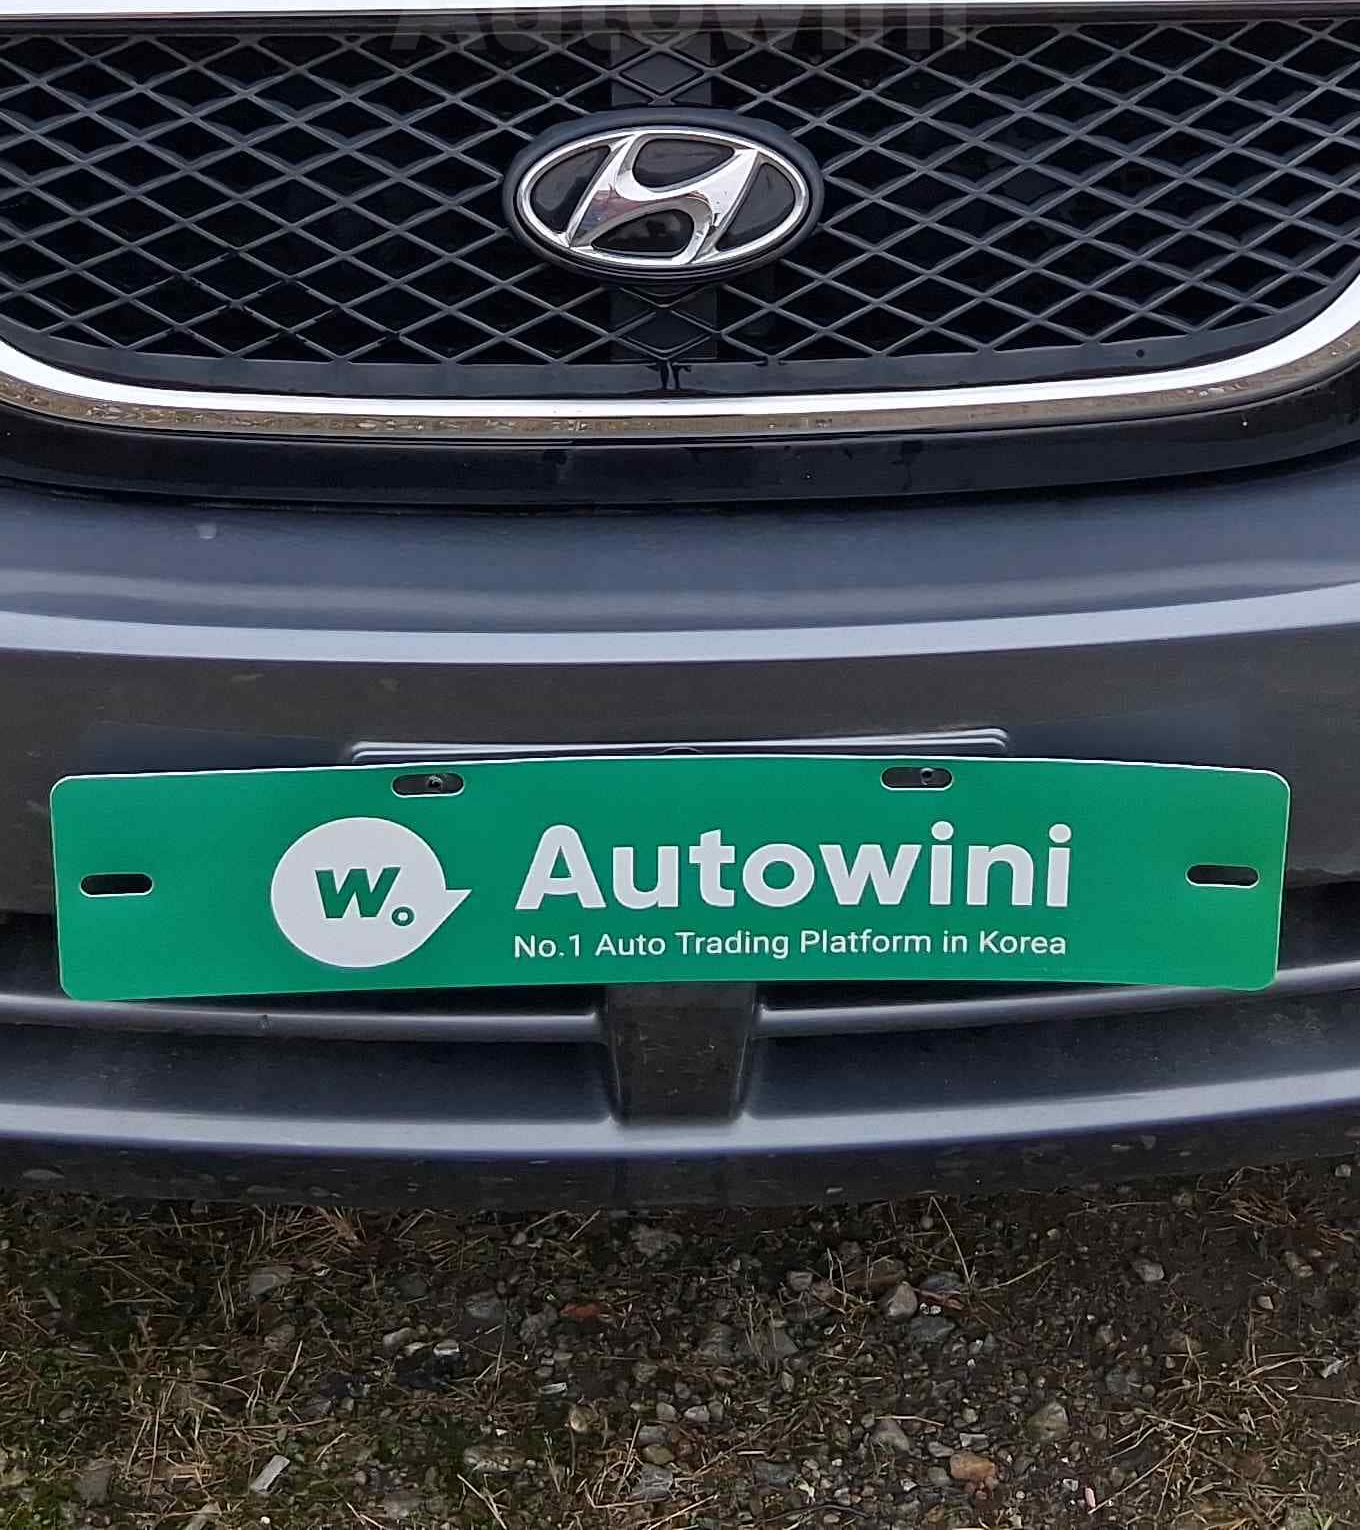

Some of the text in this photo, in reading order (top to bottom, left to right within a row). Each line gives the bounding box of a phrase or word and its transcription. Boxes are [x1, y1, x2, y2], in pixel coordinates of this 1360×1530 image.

[514, 820, 1072, 910] Autowini
[513, 927, 1067, 960] No.1 Auto Trading Platform in Korea
